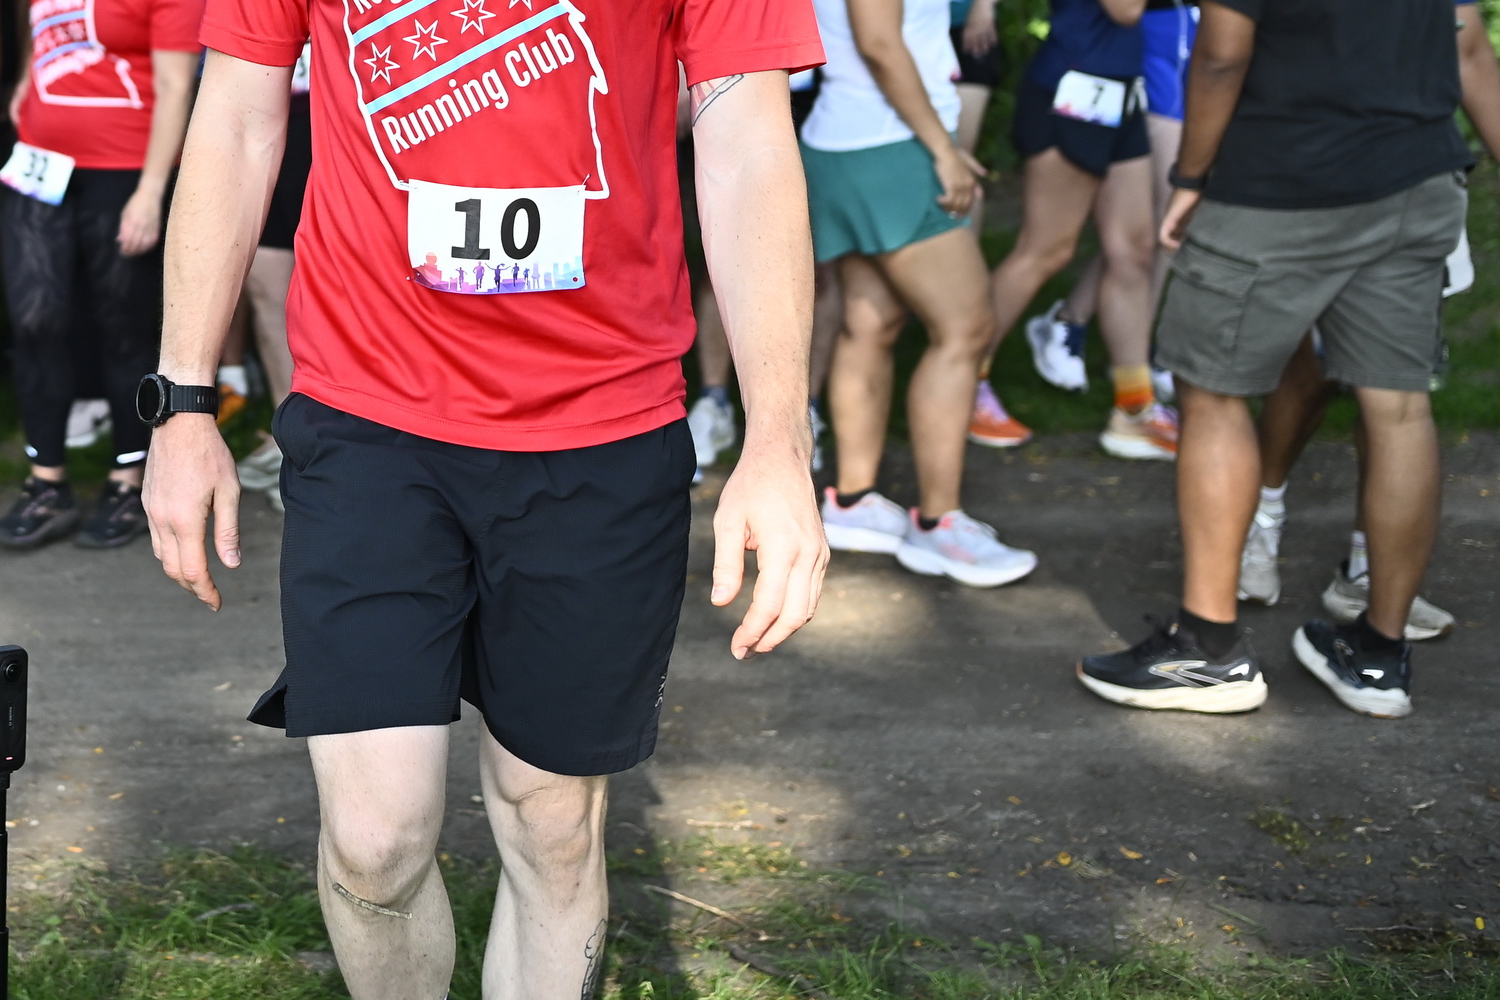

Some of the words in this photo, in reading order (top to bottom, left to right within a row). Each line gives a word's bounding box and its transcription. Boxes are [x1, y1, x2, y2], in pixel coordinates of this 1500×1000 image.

[381, 68, 509, 155] Running
[504, 27, 576, 88] Club
[450, 197, 541, 261] 10
